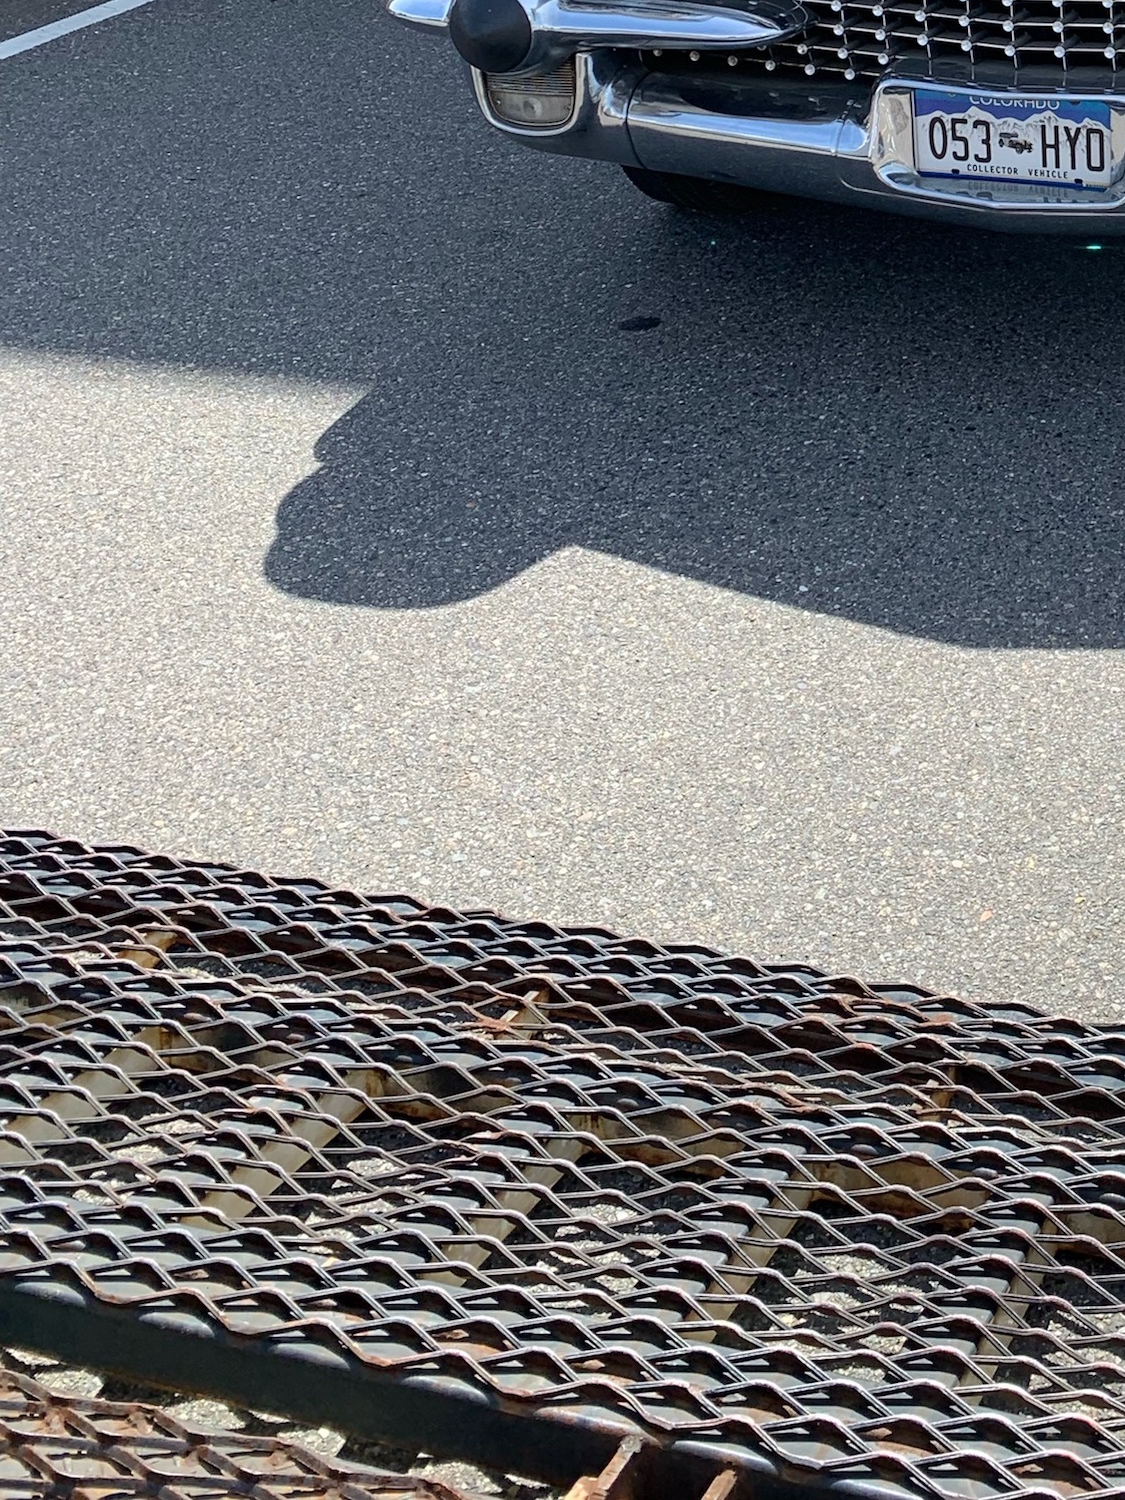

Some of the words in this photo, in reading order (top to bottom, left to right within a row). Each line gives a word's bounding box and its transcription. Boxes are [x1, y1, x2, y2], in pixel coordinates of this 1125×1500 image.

[928, 117, 992, 163] 053
[967, 164, 1018, 175] COLLECTOR
[1028, 168, 1068, 179] VEHICLE
